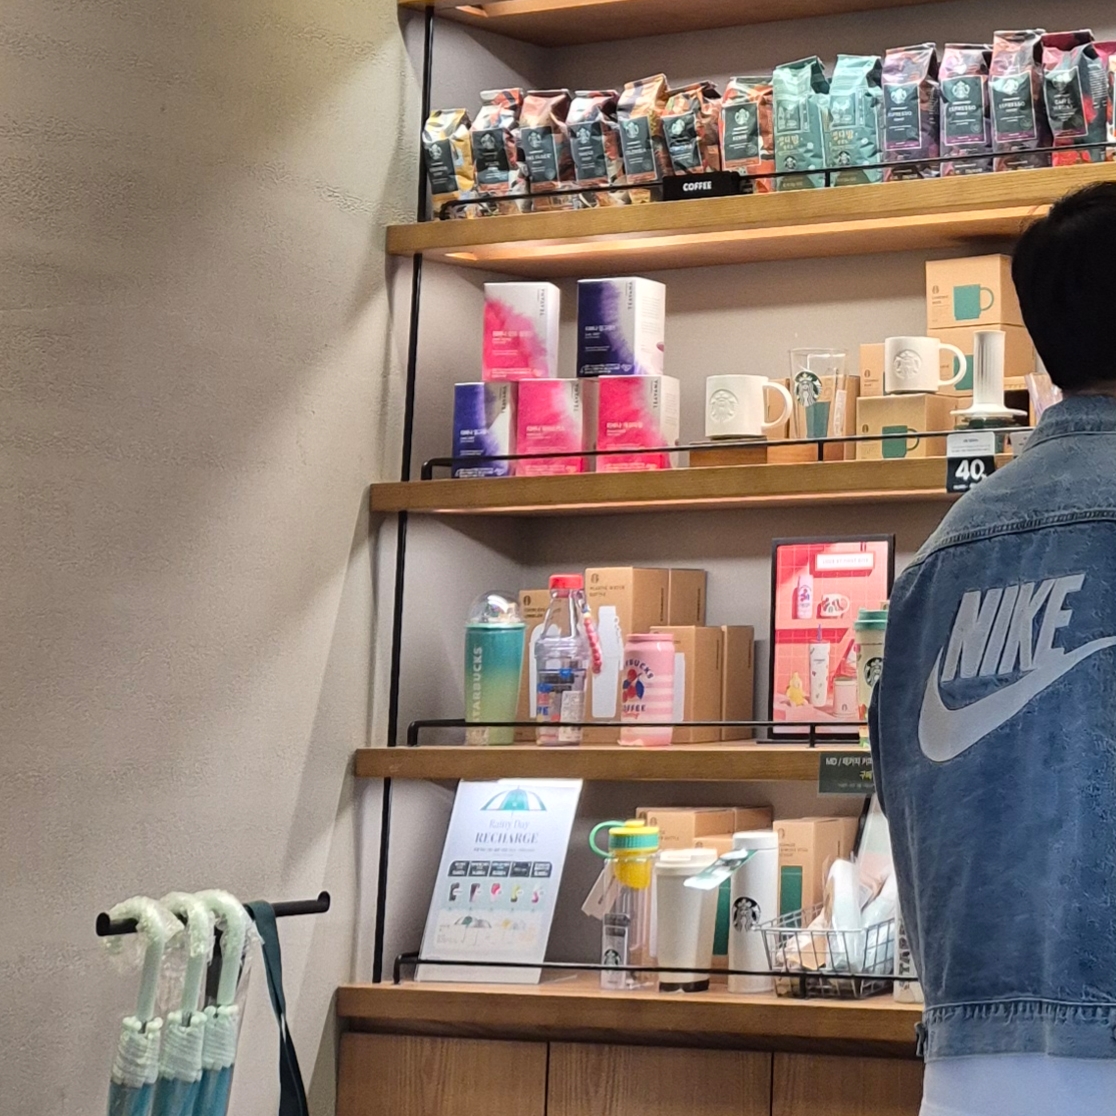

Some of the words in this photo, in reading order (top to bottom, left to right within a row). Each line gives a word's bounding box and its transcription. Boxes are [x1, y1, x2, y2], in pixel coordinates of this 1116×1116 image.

[682, 180, 712, 191] COFFEE
[955, 458, 987, 481] 40
[940, 573, 1086, 682] NIKE
[624, 658, 654, 679] BUCKS
[825, 757, 837, 766] MD
[489, 819, 512, 830] Rainy
[513, 820, 530, 830] Day
[474, 832, 539, 844] RECHARGE
